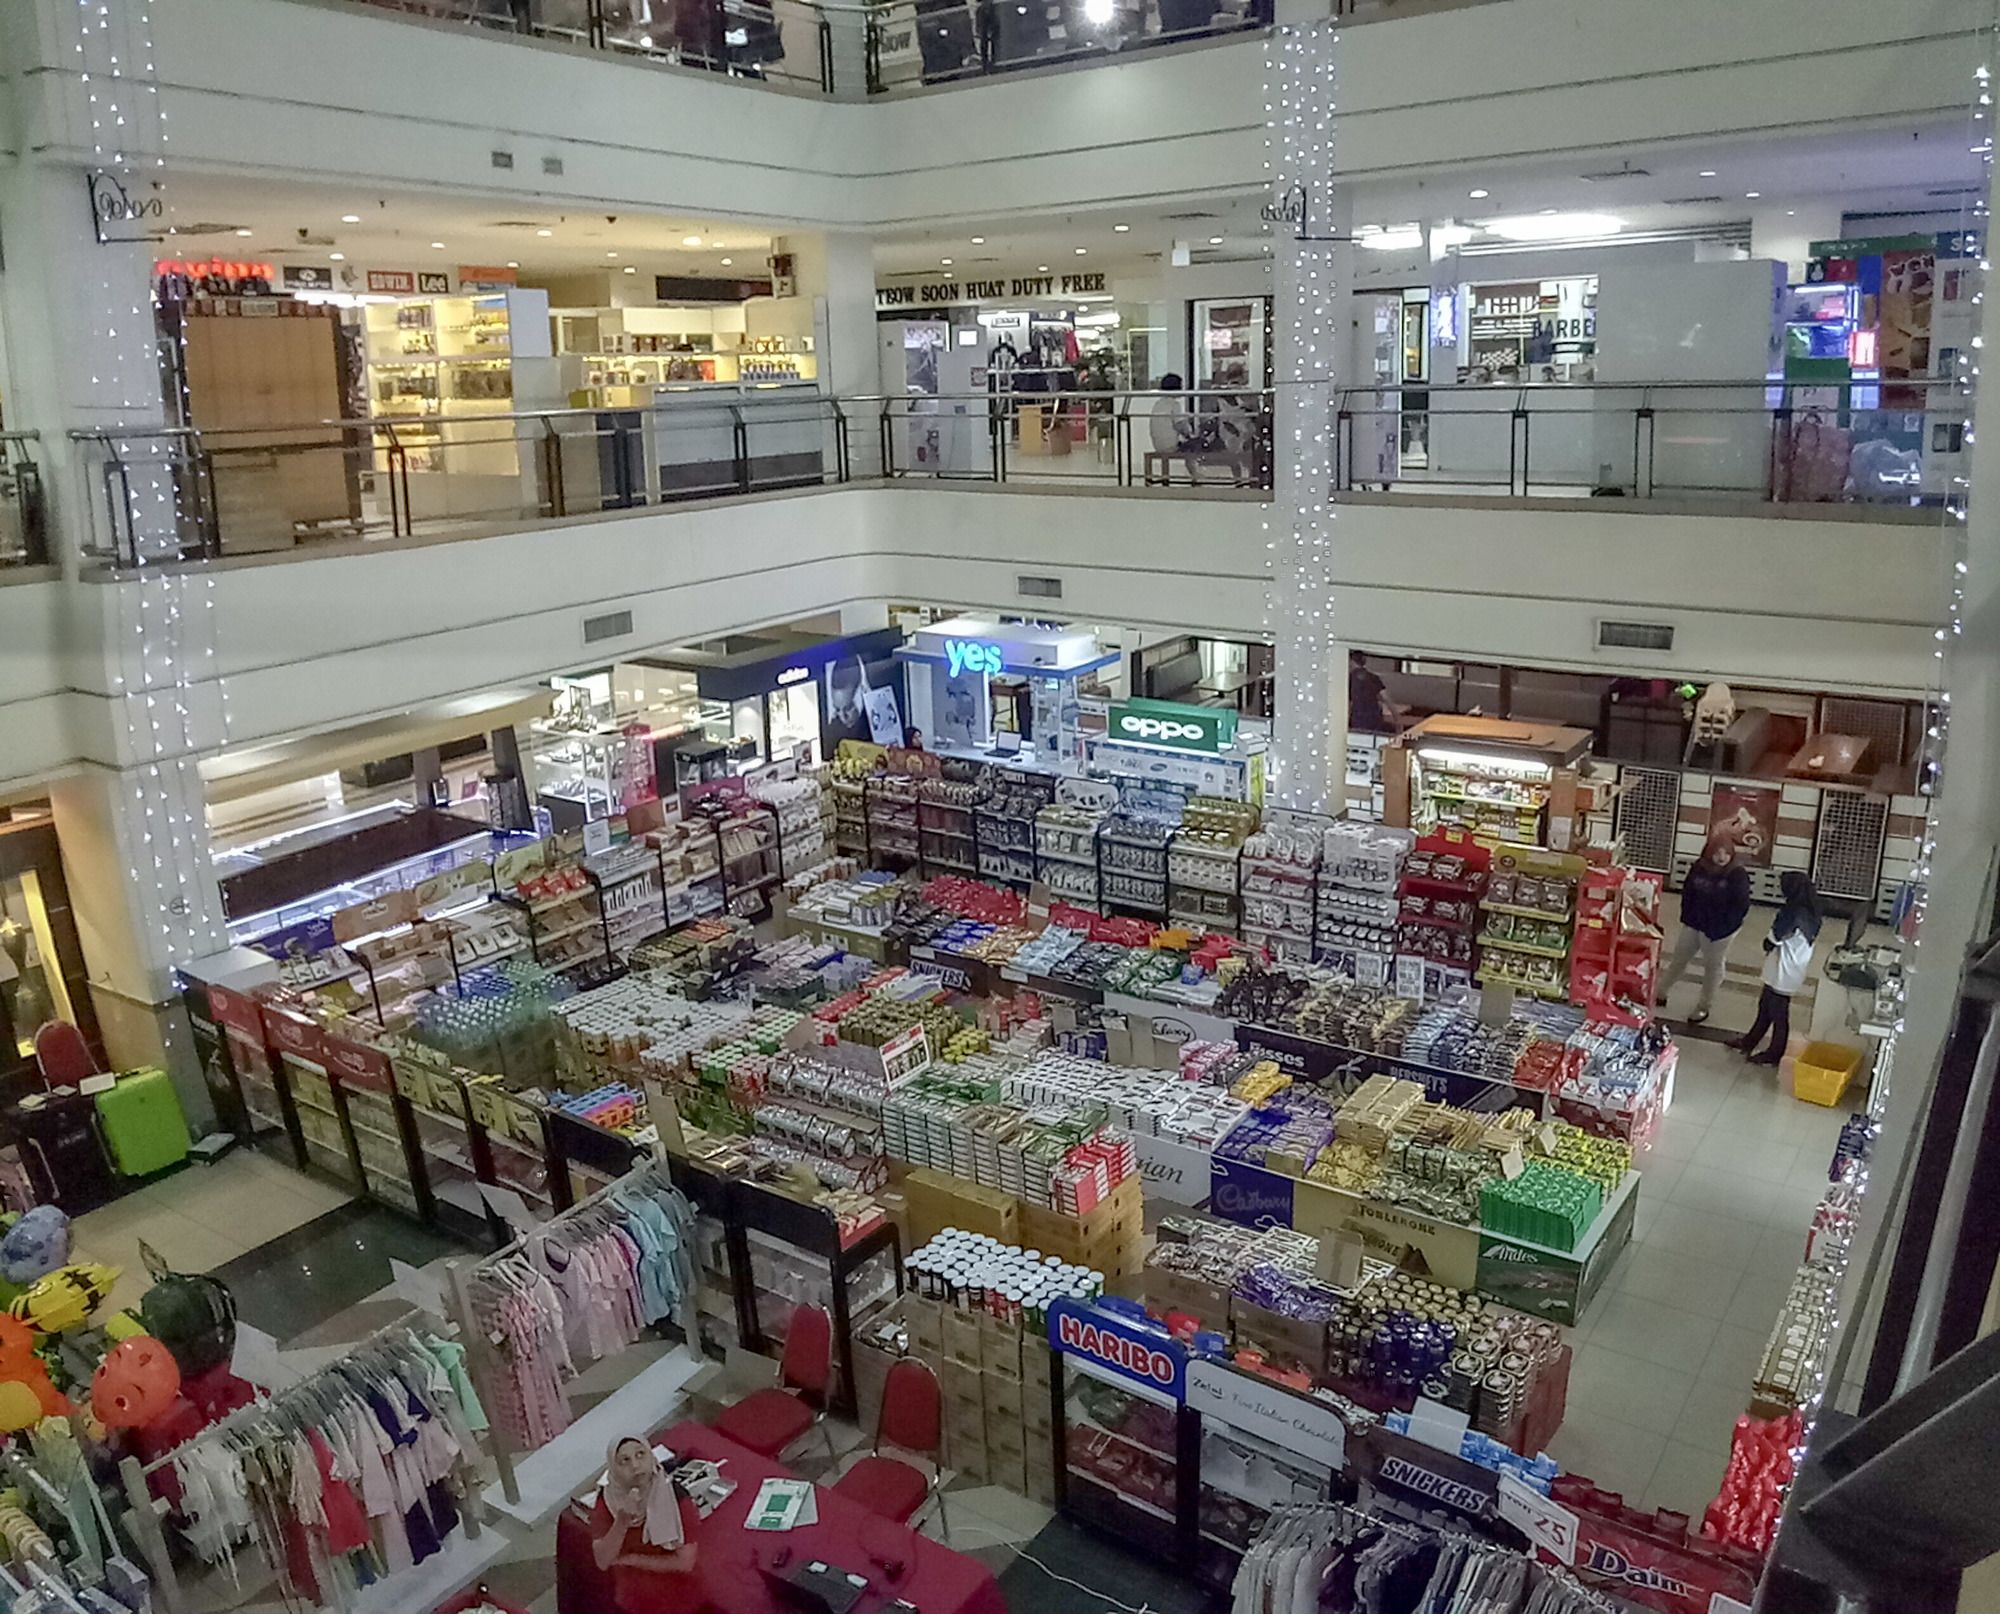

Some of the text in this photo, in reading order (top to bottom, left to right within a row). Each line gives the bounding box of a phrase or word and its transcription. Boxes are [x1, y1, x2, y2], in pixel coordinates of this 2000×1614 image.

[420, 274, 446, 293] Lee
[876, 273, 1105, 306] TEOW SOON HUAT DUTY FREE
[944, 639, 1003, 678] yes
[1120, 715, 1204, 740] oppo
[1359, 1204, 1436, 1236] TOBLERONE
[1059, 1313, 1176, 1385] HARIBO
[1382, 1456, 1489, 1513] SNICKERS
[1582, 1539, 1691, 1597] Daim
